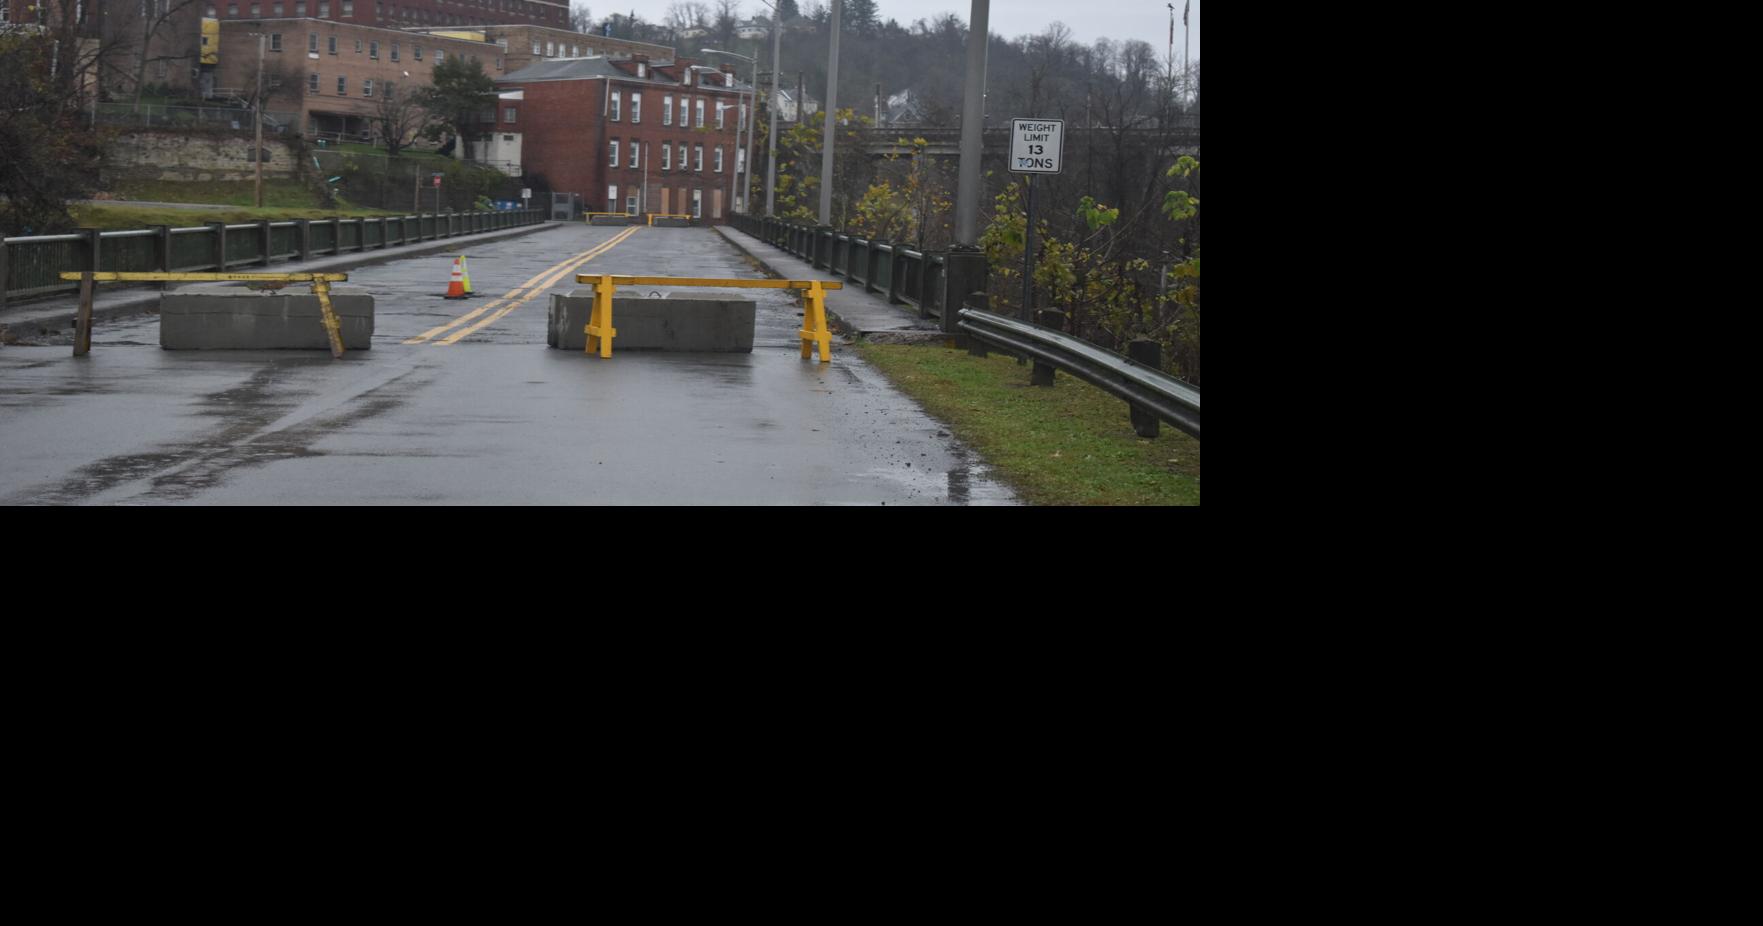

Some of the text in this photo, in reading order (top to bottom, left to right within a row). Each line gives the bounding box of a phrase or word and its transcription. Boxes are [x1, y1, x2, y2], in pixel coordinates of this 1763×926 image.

[1019, 123, 1056, 132] WEIGHT
[1024, 133, 1049, 142] LIMIT
[1028, 145, 1044, 155] 13
[1017, 157, 1053, 169] TONS
